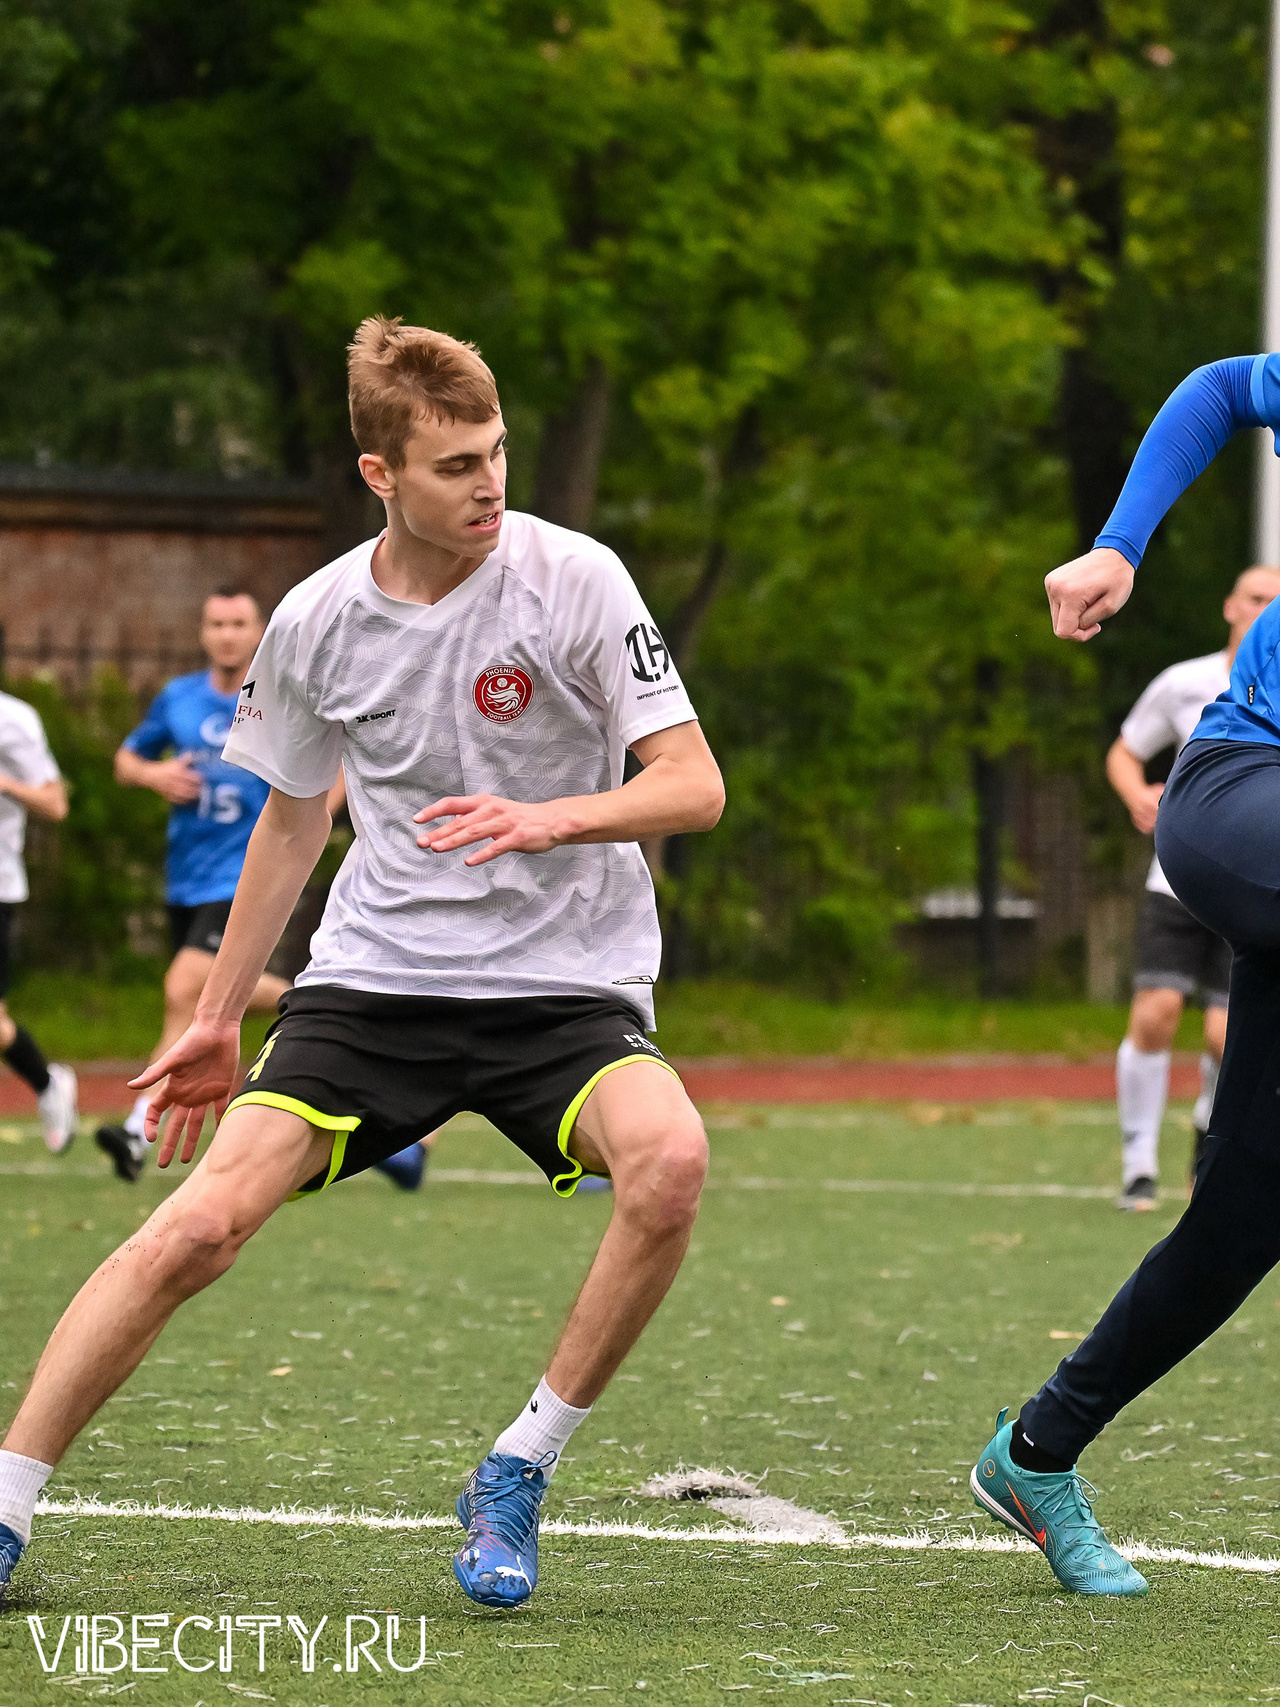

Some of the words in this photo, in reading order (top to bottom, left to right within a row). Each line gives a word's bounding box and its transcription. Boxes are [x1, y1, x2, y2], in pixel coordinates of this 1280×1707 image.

[485, 667, 516, 678] PHOENIX
[238, 705, 263, 721] FIA
[369, 709, 396, 721] SPORT
[486, 711, 512, 721] FOOTBALL
[512, 706, 524, 718] TEAM
[197, 783, 242, 825] 15
